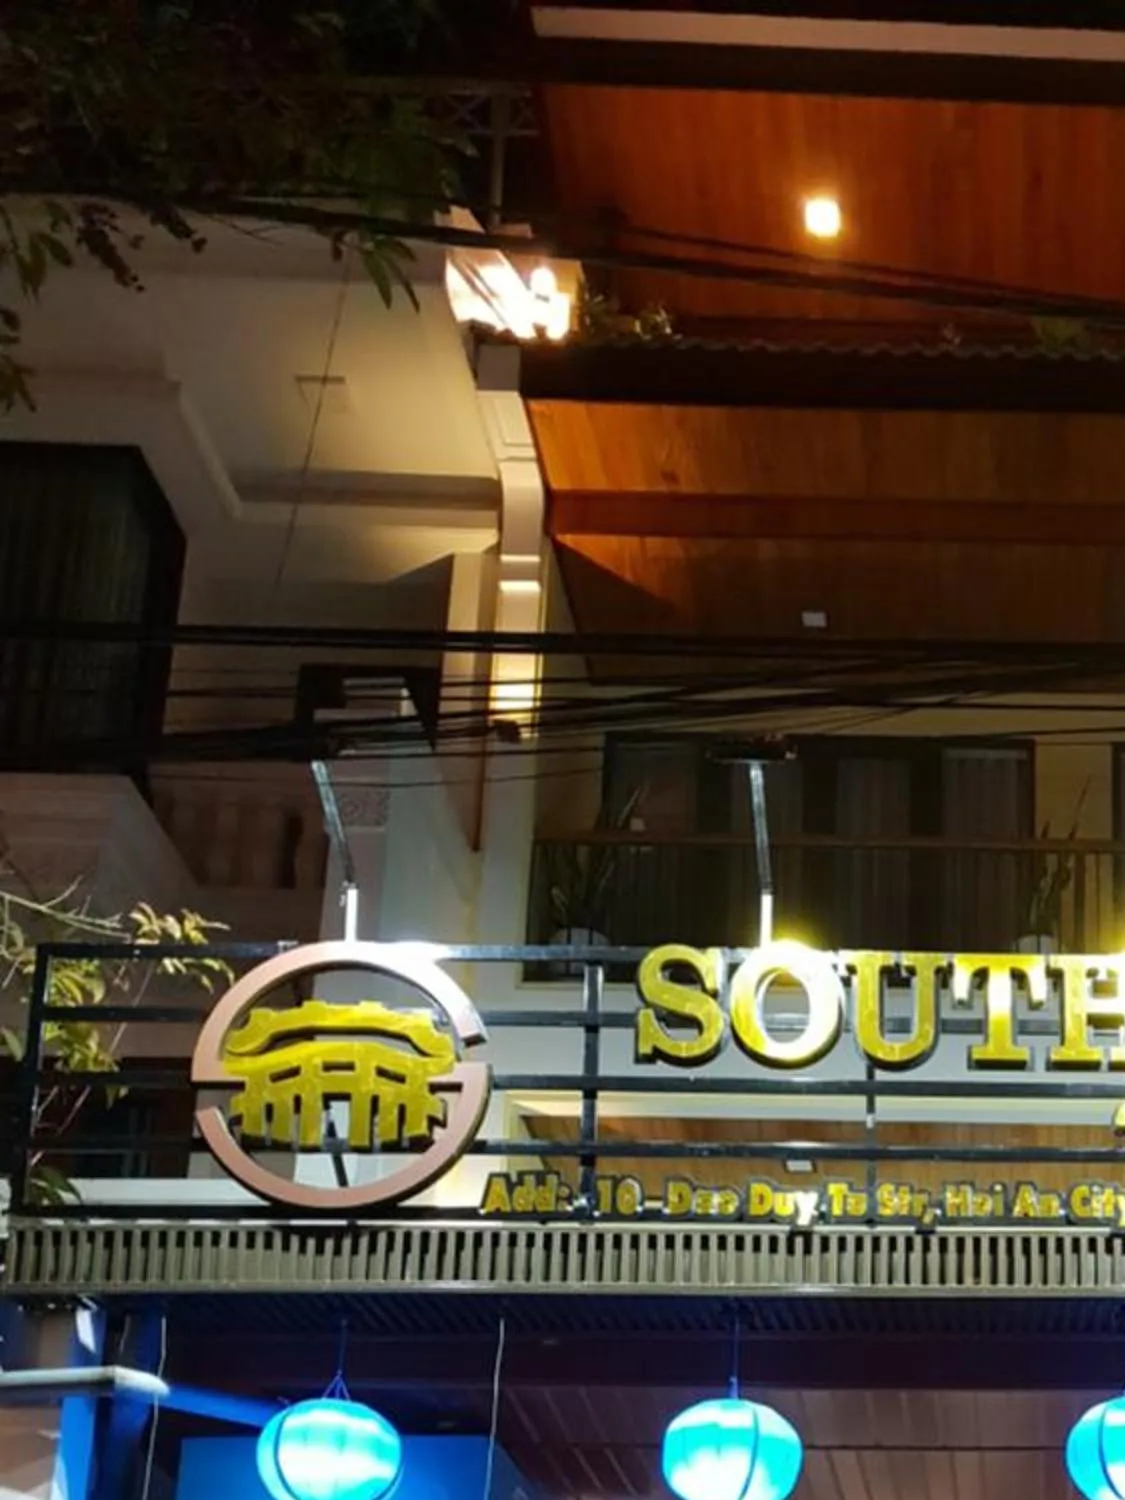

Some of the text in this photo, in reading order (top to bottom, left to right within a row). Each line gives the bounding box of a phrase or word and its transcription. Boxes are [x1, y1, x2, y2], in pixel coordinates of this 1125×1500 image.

[481, 1173, 572, 1216] Add:
[750, 1182, 818, 1227] Duy
[944, 1184, 1004, 1217] Hoi
[1012, 1184, 1061, 1217] An
